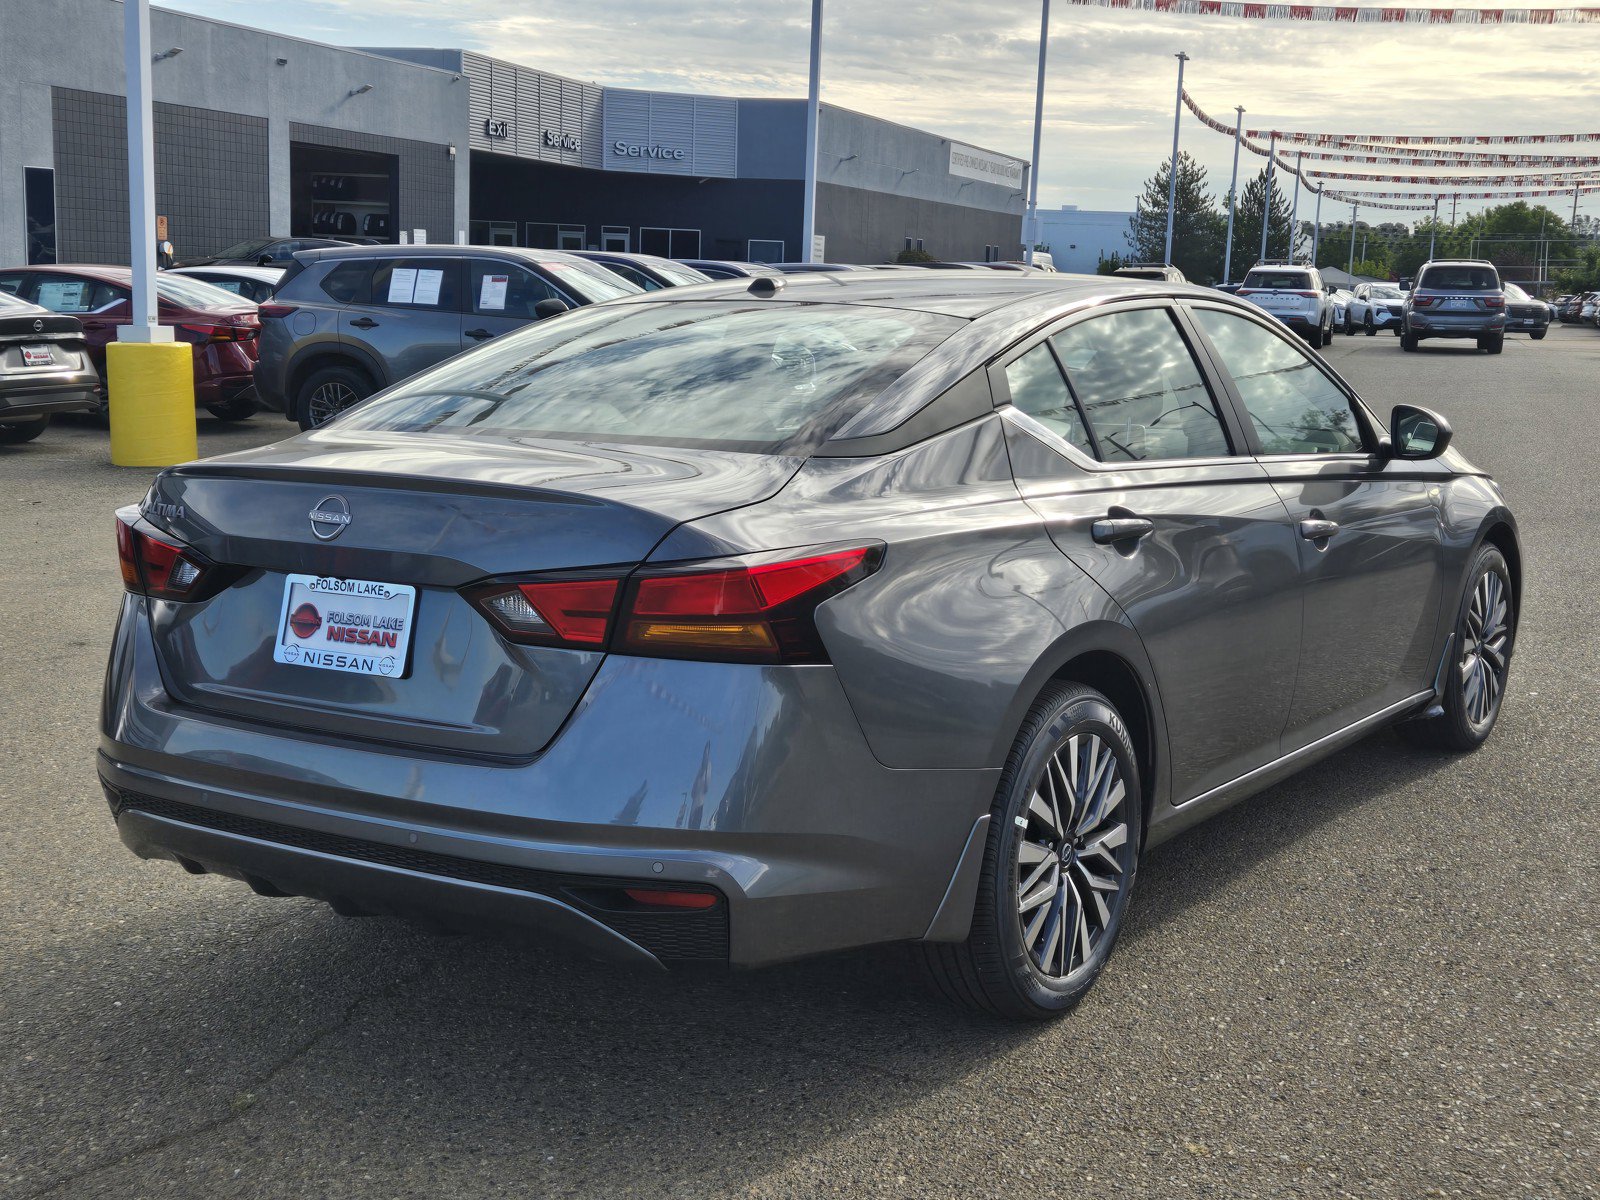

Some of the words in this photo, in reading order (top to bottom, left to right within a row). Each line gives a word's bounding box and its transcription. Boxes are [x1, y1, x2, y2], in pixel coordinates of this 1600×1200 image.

[487, 119, 510, 138] Exit
[546, 129, 581, 151] Service
[614, 140, 685, 160] Service
[308, 511, 351, 523] NISSAN
[315, 578, 355, 593] FOLSOM
[357, 582, 385, 596] LAKE
[326, 610, 371, 627] FOLSOM
[372, 615, 404, 630] LAKE
[326, 625, 398, 648] NISSAN
[303, 651, 374, 672] NISSAN
